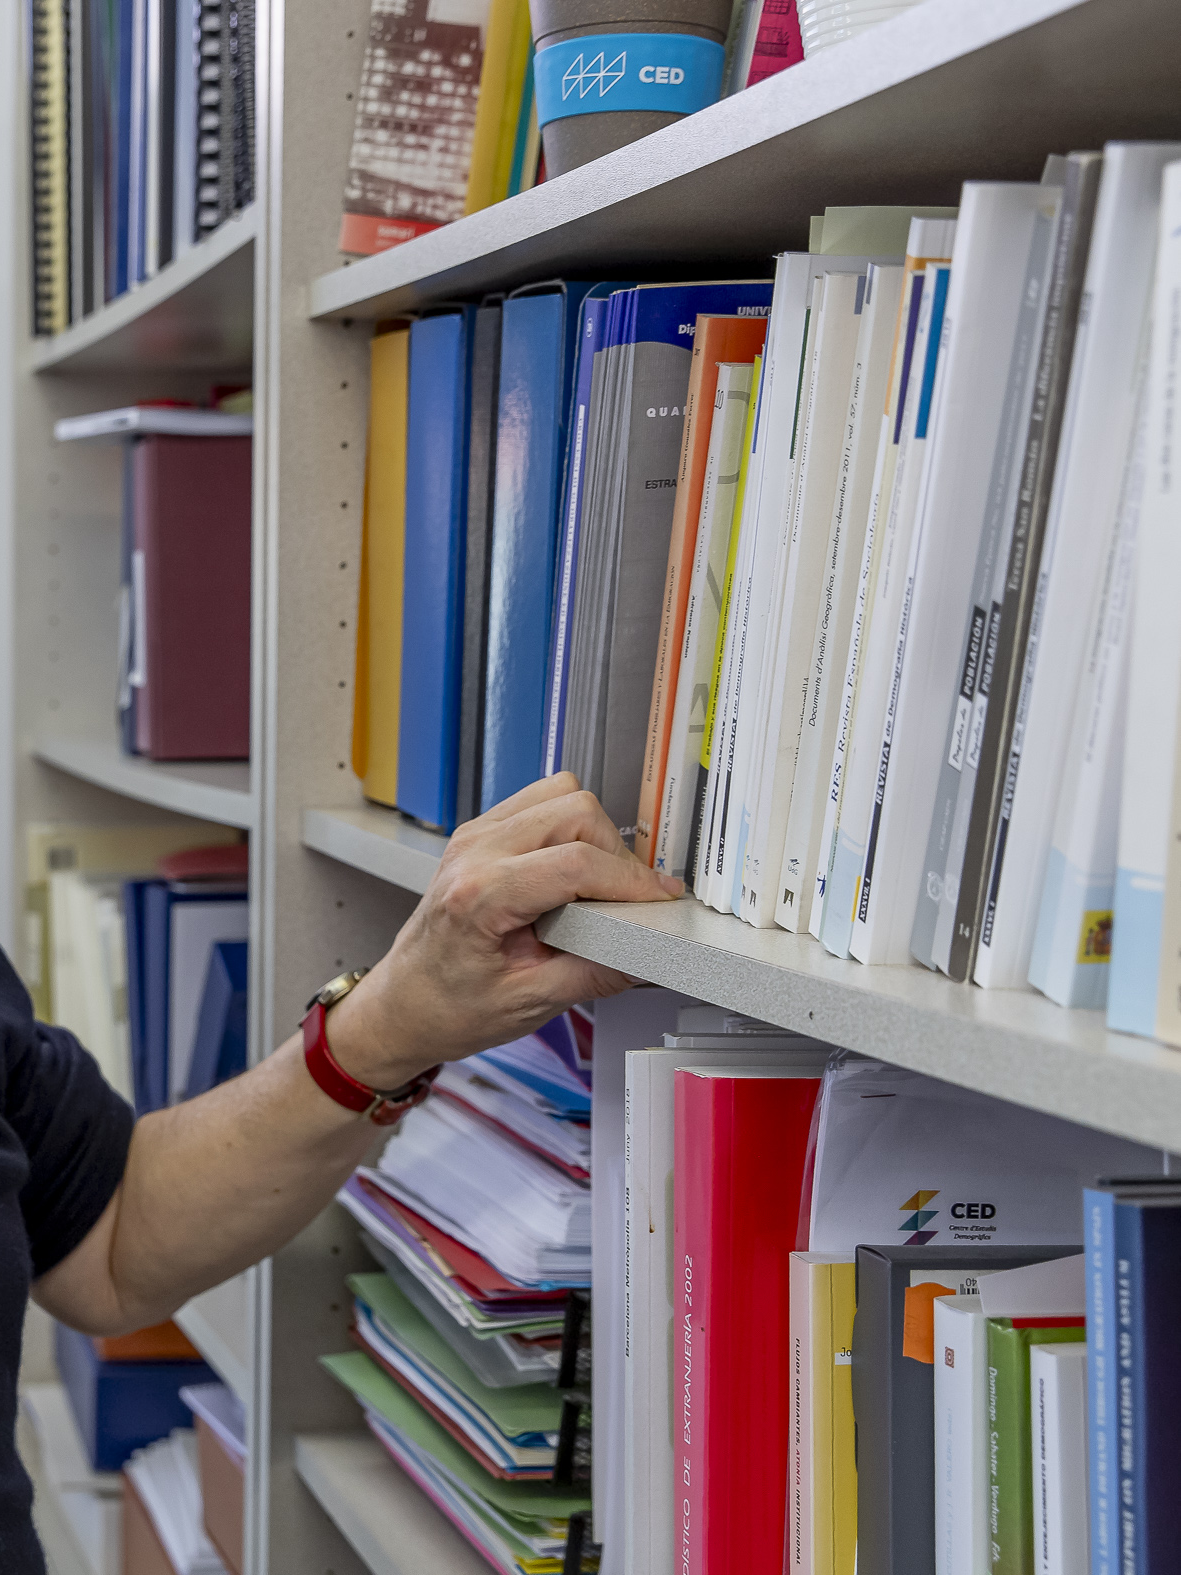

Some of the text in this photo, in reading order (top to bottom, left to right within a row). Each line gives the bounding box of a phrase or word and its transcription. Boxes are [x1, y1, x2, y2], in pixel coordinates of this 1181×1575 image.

[638, 66, 685, 85] CED
[846, 423, 855, 440] vol.
[841, 443, 852, 472] 2011,
[828, 476, 848, 570] setembre-desembre
[860, 492, 879, 579] Sociología
[819, 574, 836, 629] Geogràfica,
[857, 587, 866, 606] de
[814, 631, 827, 673] d'Anàlisi
[845, 612, 863, 687] Española
[961, 616, 984, 696] POBLACIÓN
[979, 612, 1001, 693] POBLACIÓN
[807, 676, 822, 726] Documents
[874, 742, 890, 804] REVISTA
[886, 640, 905, 715] Demografía
[898, 577, 913, 635] Histórica
[836, 695, 852, 752] Revista
[829, 762, 843, 802] RES
[950, 1202, 997, 1220] CED
[970, 1225, 997, 1233] d'Estudis
[684, 1254, 693, 1306] 2002
[682, 1313, 691, 1444] EXTRANJERÍA
[989, 1366, 997, 1421] Domingo
[683, 1456, 691, 1486] DE
[990, 1431, 998, 1476] Sabater
